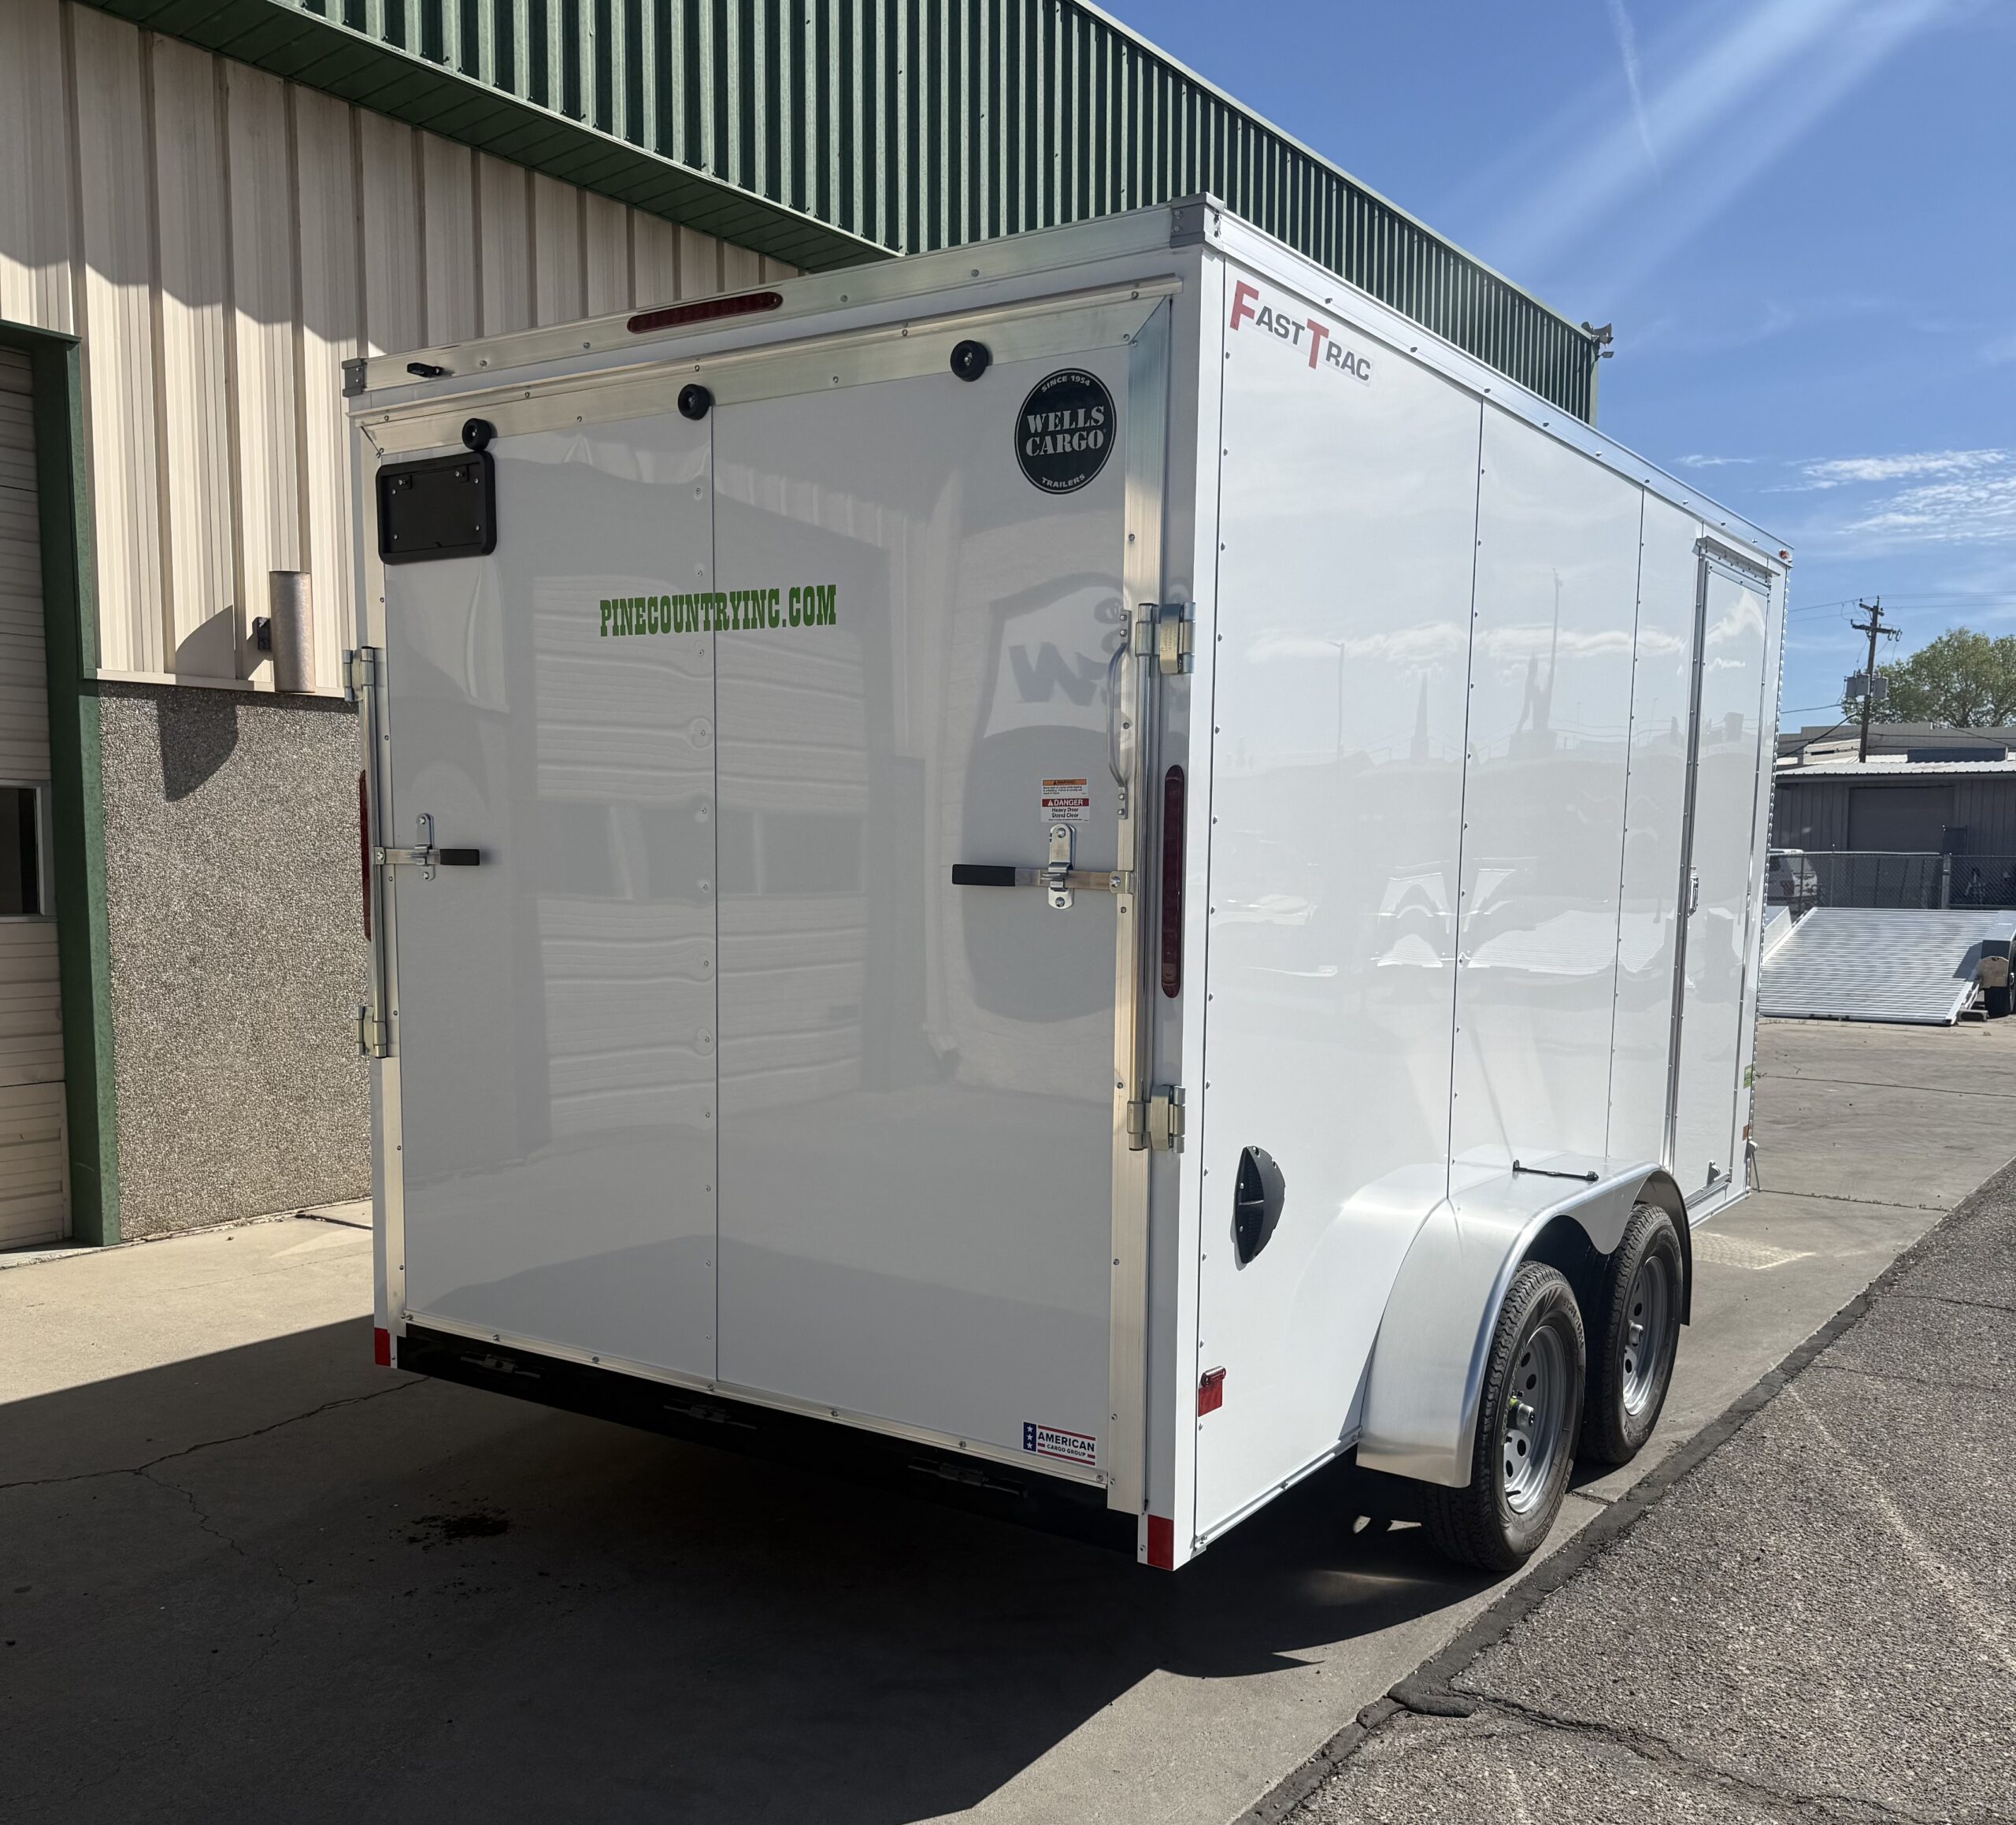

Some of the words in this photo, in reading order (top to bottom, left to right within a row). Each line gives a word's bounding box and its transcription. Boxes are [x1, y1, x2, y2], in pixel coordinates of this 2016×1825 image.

[1041, 376, 1068, 393] SINCE
[1070, 375, 1091, 387] 1954
[1027, 406, 1105, 433] WELLS
[1025, 429, 1104, 457] CARGO
[1041, 473, 1085, 488] TRAILERS
[599, 584, 836, 637] PINECOUNTRYINC.COM
[1038, 1431, 1095, 1452] AMERICAN
[1047, 1444, 1066, 1452] CARGO
[1066, 1448, 1086, 1457] GROUP
